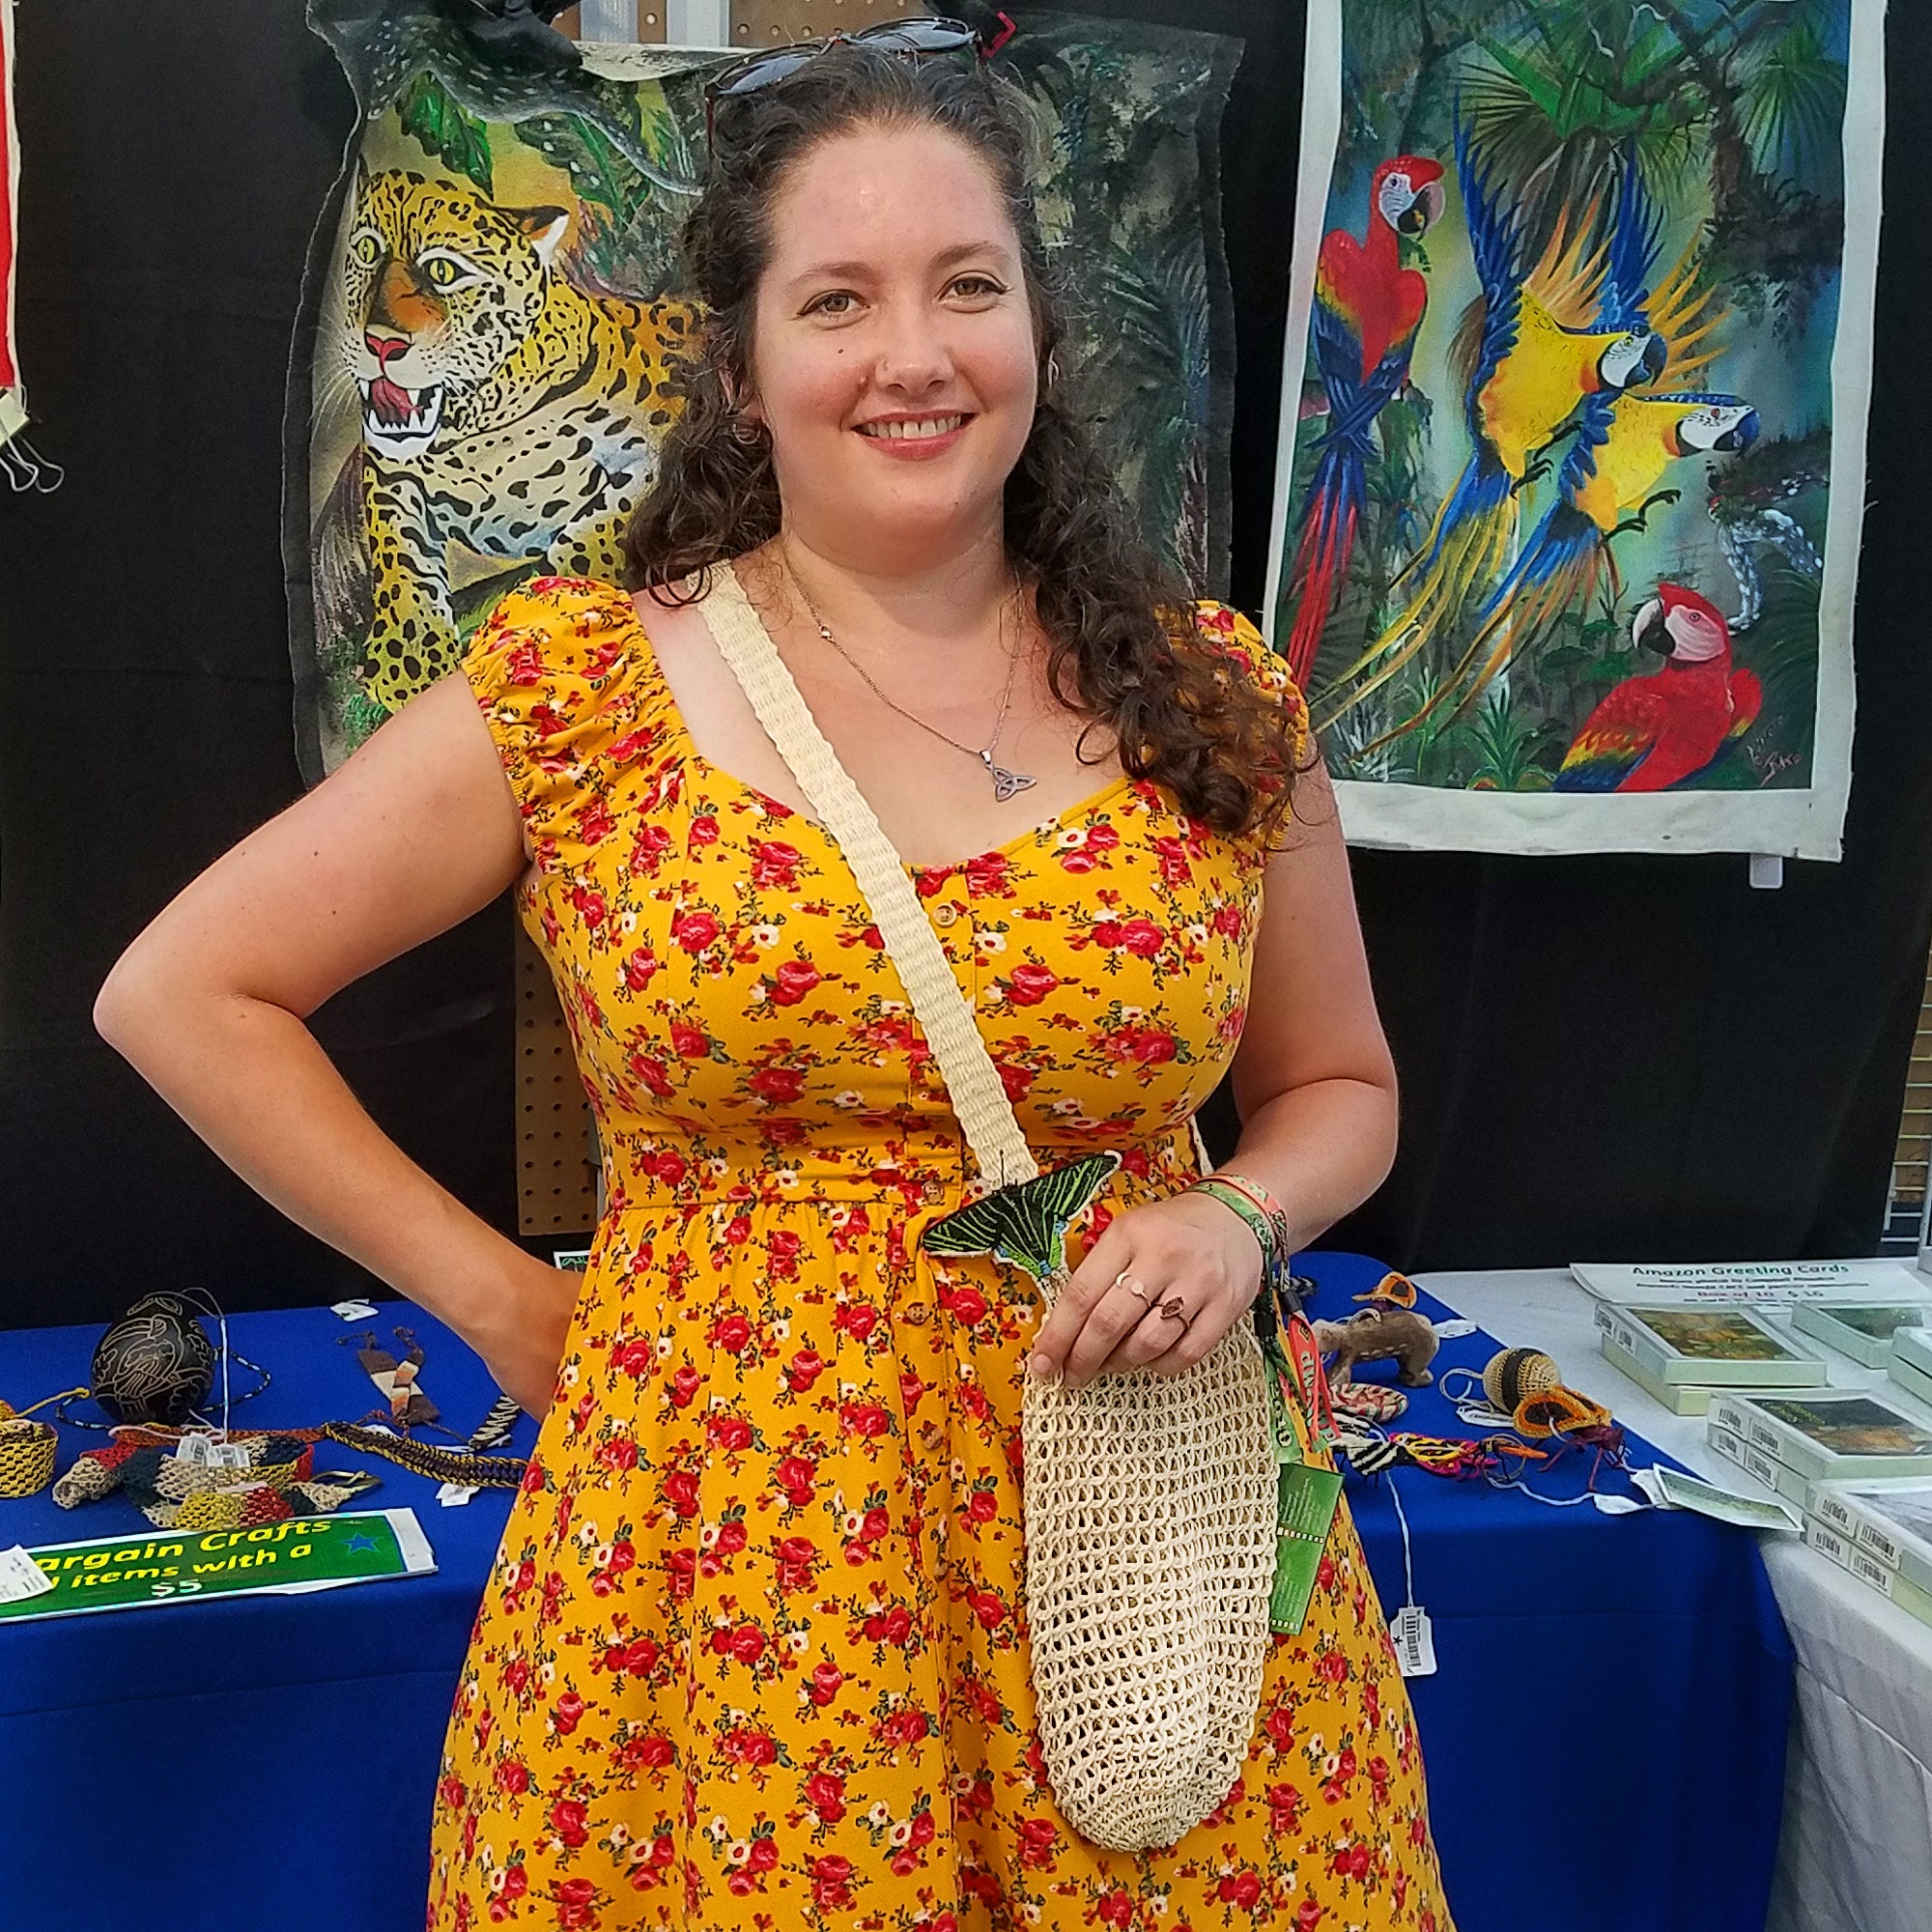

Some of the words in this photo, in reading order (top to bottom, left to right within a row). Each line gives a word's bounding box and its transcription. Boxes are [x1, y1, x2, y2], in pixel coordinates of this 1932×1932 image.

[1633, 1266, 1706, 1276] Amazon
[1711, 1265, 1792, 1275] Greeting
[1797, 1264, 1849, 1273] Cards
[34, 1543, 184, 1572] argain
[200, 1520, 331, 1551] Crafts
[71, 1566, 180, 1588] items
[192, 1548, 277, 1574] with
[290, 1544, 311, 1558] a
[151, 1578, 203, 1597] $5
